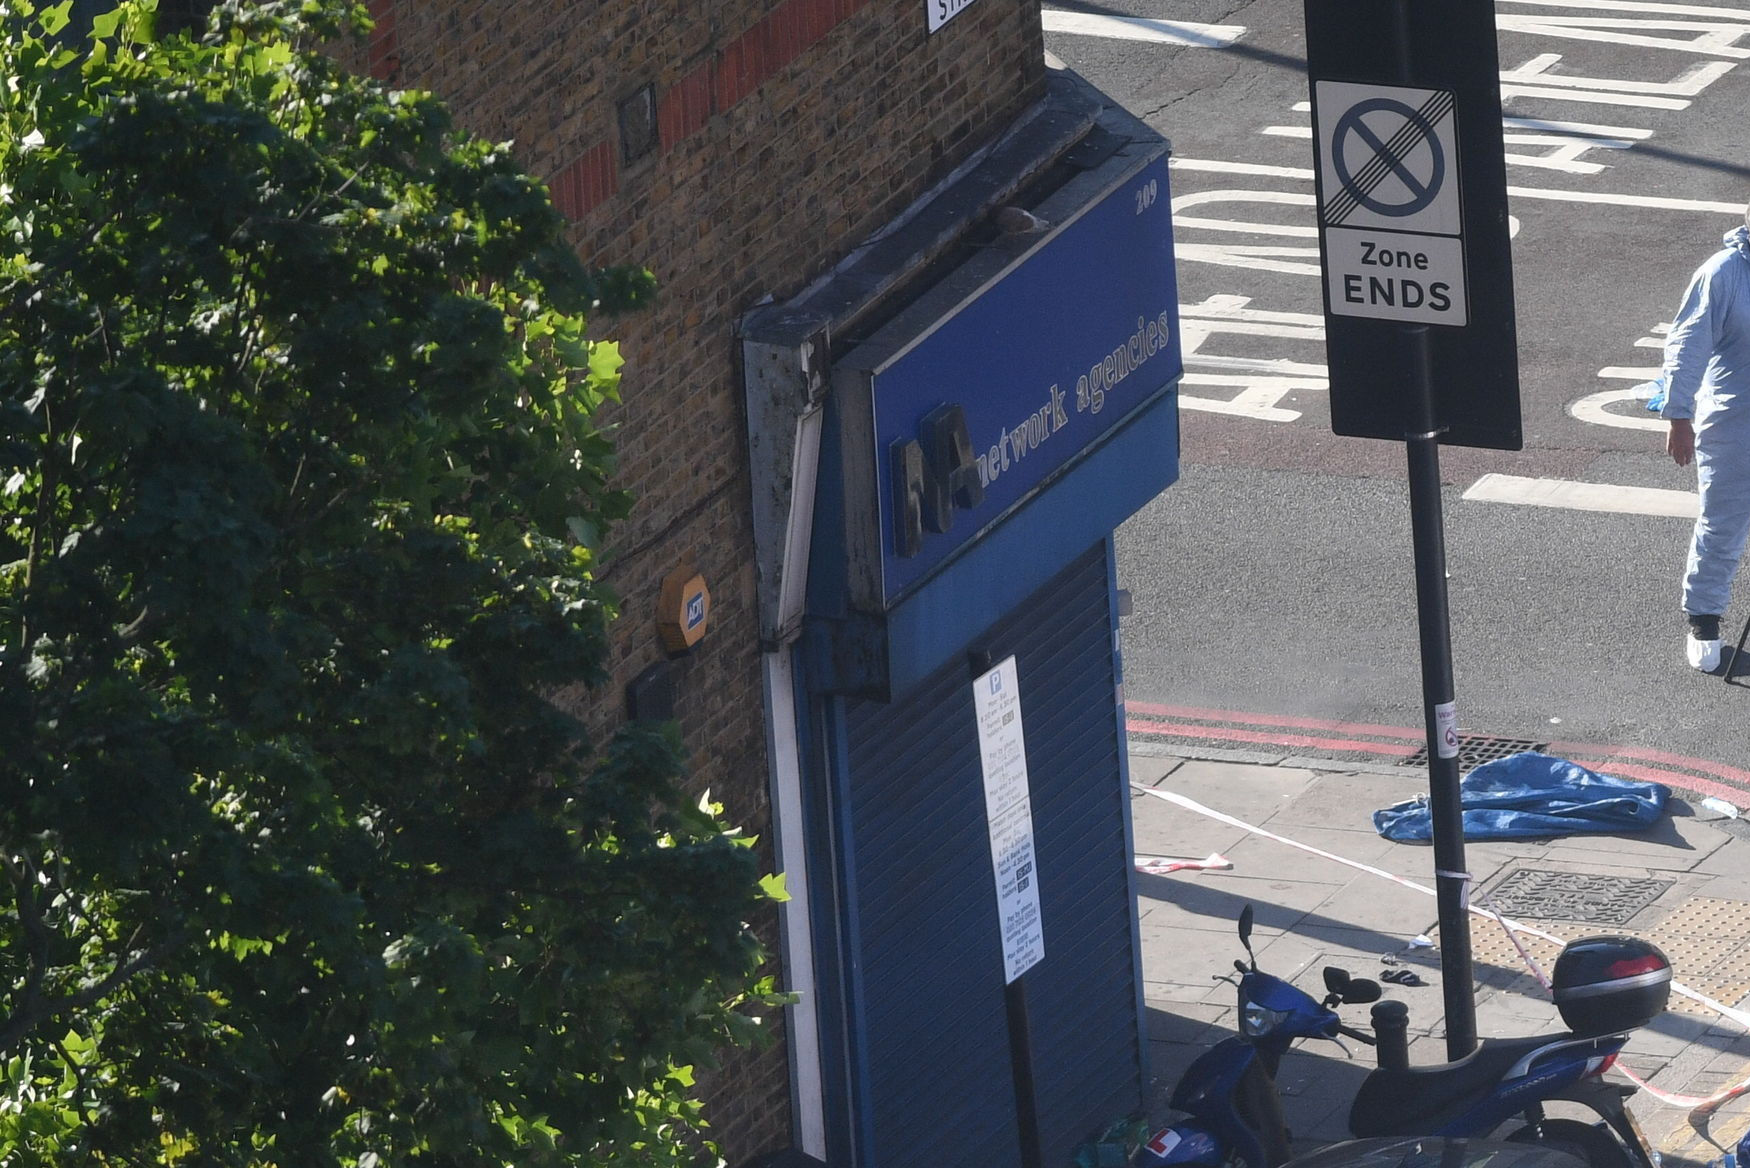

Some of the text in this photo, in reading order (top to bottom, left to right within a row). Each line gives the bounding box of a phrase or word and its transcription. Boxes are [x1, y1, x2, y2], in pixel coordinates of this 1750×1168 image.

[1136, 179, 1158, 216] 209
[1360, 241, 1429, 270] Zone
[1344, 274, 1451, 311] ENDS
[976, 310, 1169, 488] network agencies
[688, 597, 703, 627] ADT
